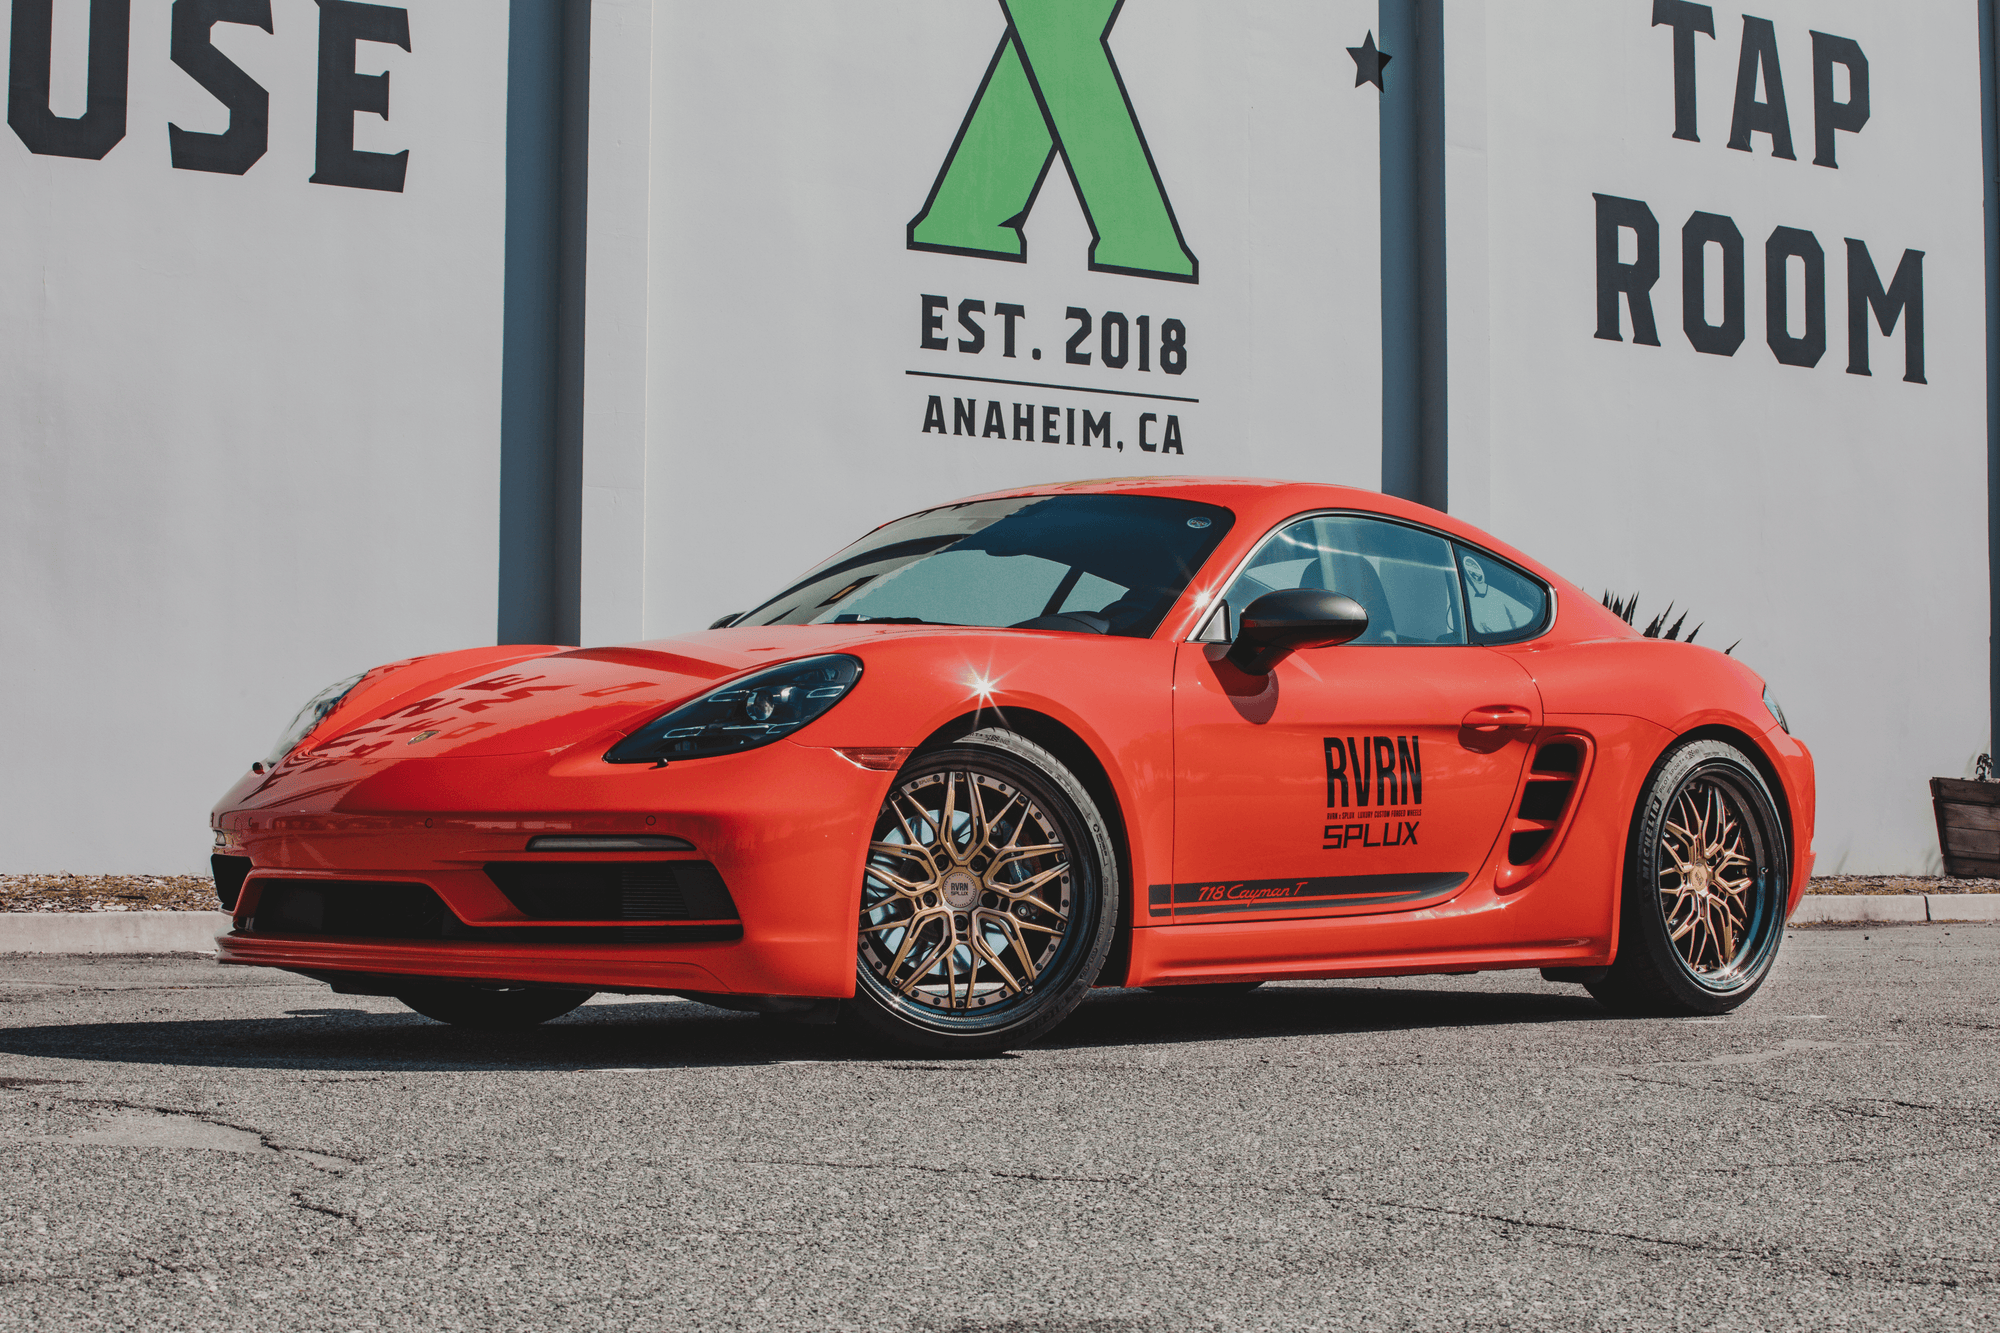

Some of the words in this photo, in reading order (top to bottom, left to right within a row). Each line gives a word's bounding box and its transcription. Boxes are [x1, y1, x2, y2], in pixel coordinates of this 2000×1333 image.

[7, 0, 411, 193] USE
[1651, 0, 1871, 169] TAP
[1592, 192, 1928, 385] ROOM
[920, 293, 1042, 361] EST.
[1065, 305, 1187, 375] 2018
[922, 394, 1124, 453] ANAHEIM,
[1138, 411, 1184, 455] CA
[1323, 735, 1422, 808] RVRN
[1658, 776, 1670, 794] PILOT
[1669, 760, 1683, 776] SPORT
[1322, 820, 1420, 849] SPLUX
[1642, 800, 1661, 880] MICHELIN
[950, 882, 969, 891] RVRN
[1198, 885, 1226, 901] 718
[1226, 883, 1290, 907] Cayman
[1293, 881, 1309, 896] T
